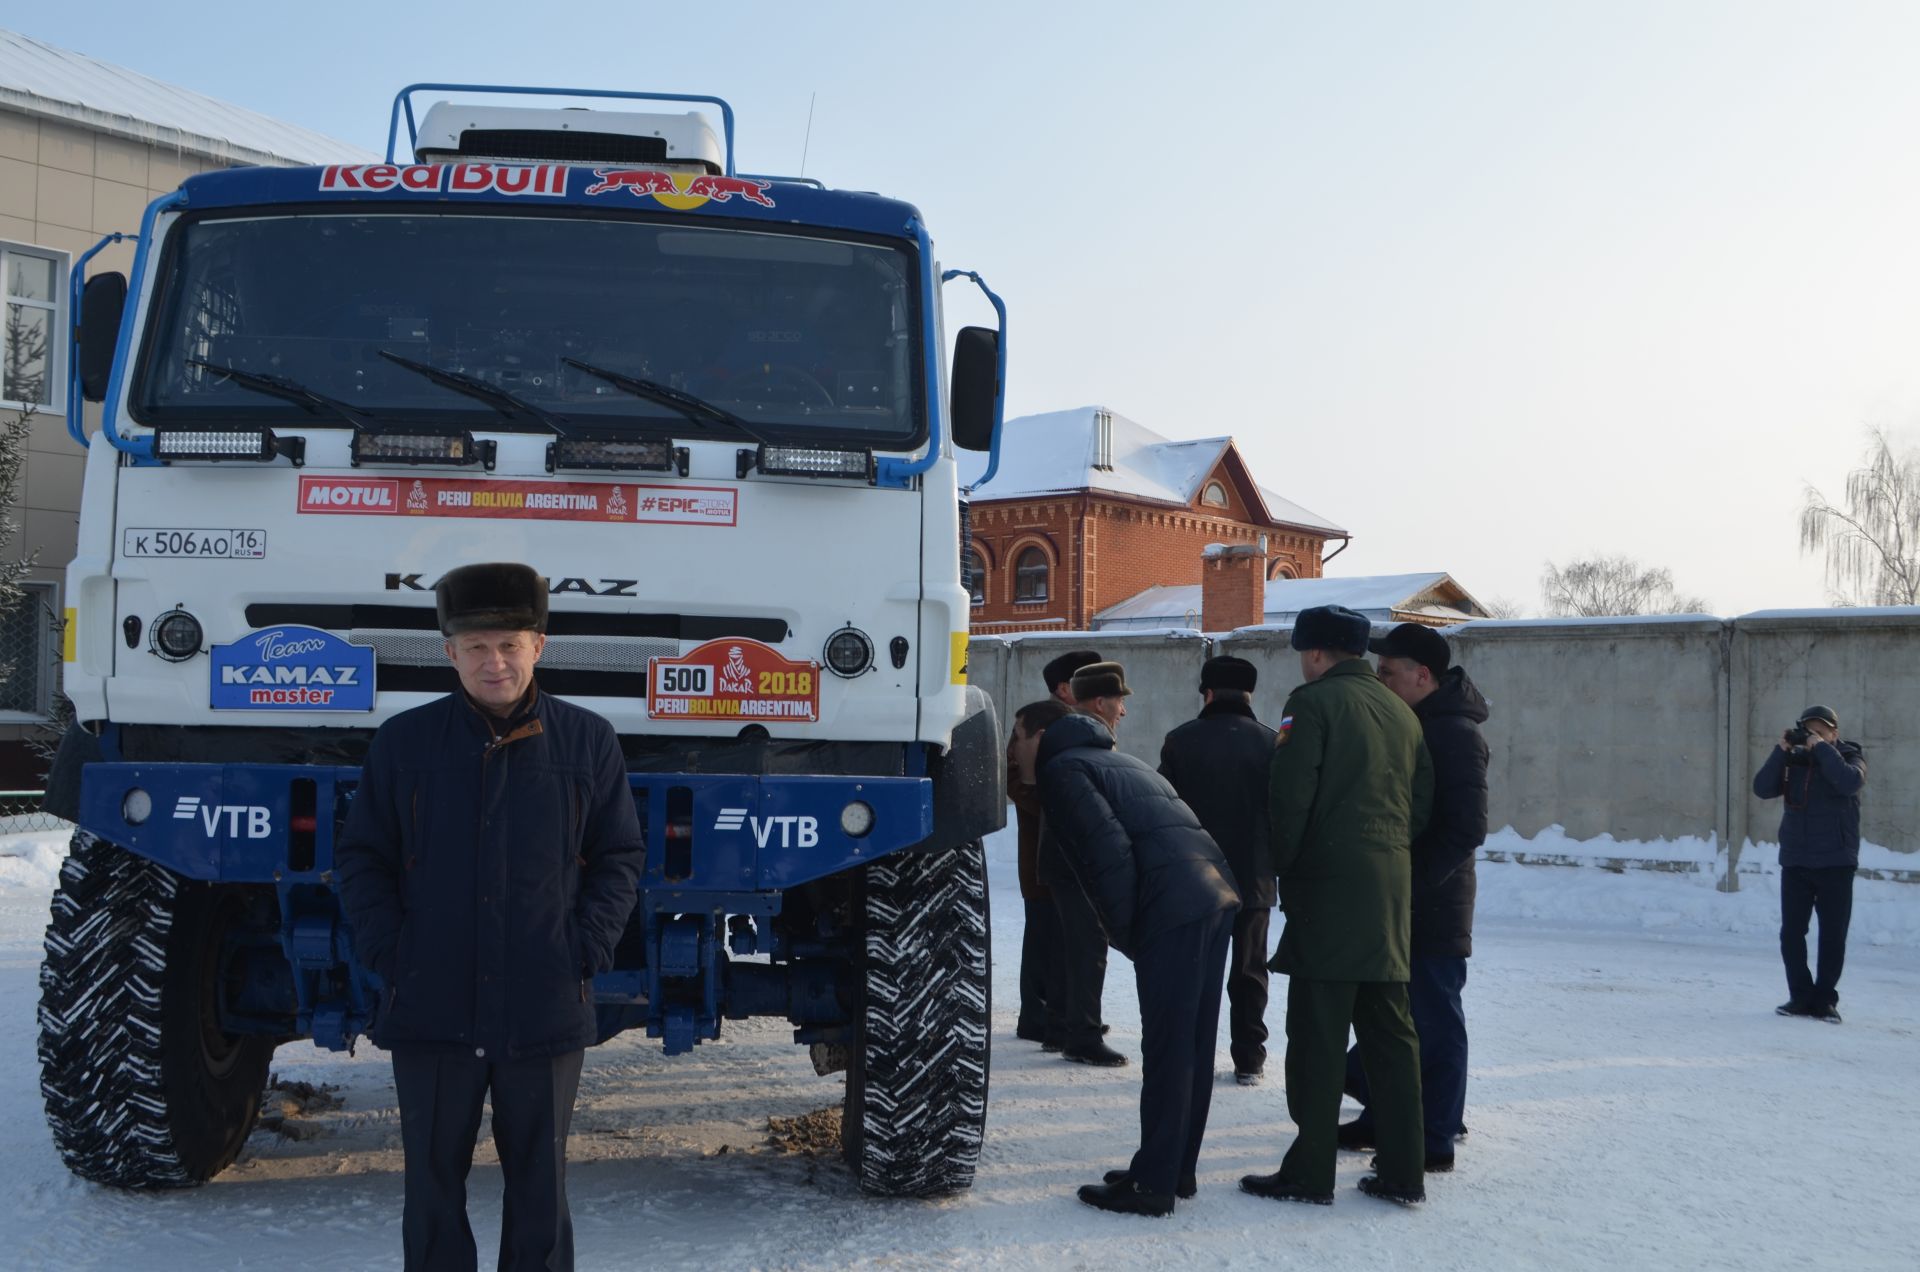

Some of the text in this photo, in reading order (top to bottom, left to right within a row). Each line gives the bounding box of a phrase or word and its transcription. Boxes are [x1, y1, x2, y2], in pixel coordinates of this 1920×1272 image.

[322, 164, 567, 193] Red Bull
[307, 485, 393, 507] MOTUL
[437, 491, 598, 511] PERU BOLIVIA ARGENTINA
[235, 531, 258, 549] 16
[385, 573, 637, 597] KAZ
[256, 631, 326, 661] Team
[221, 665, 358, 685] KAMAZ
[663, 667, 707, 693] 500
[719, 677, 754, 694] DAKAR
[758, 671, 812, 695] 2018
[250, 686, 335, 704] master
[655, 698, 812, 717] PERU BOLIVIA ARGENTINA
[201, 805, 272, 839] VTB
[749, 816, 819, 848] VTB
